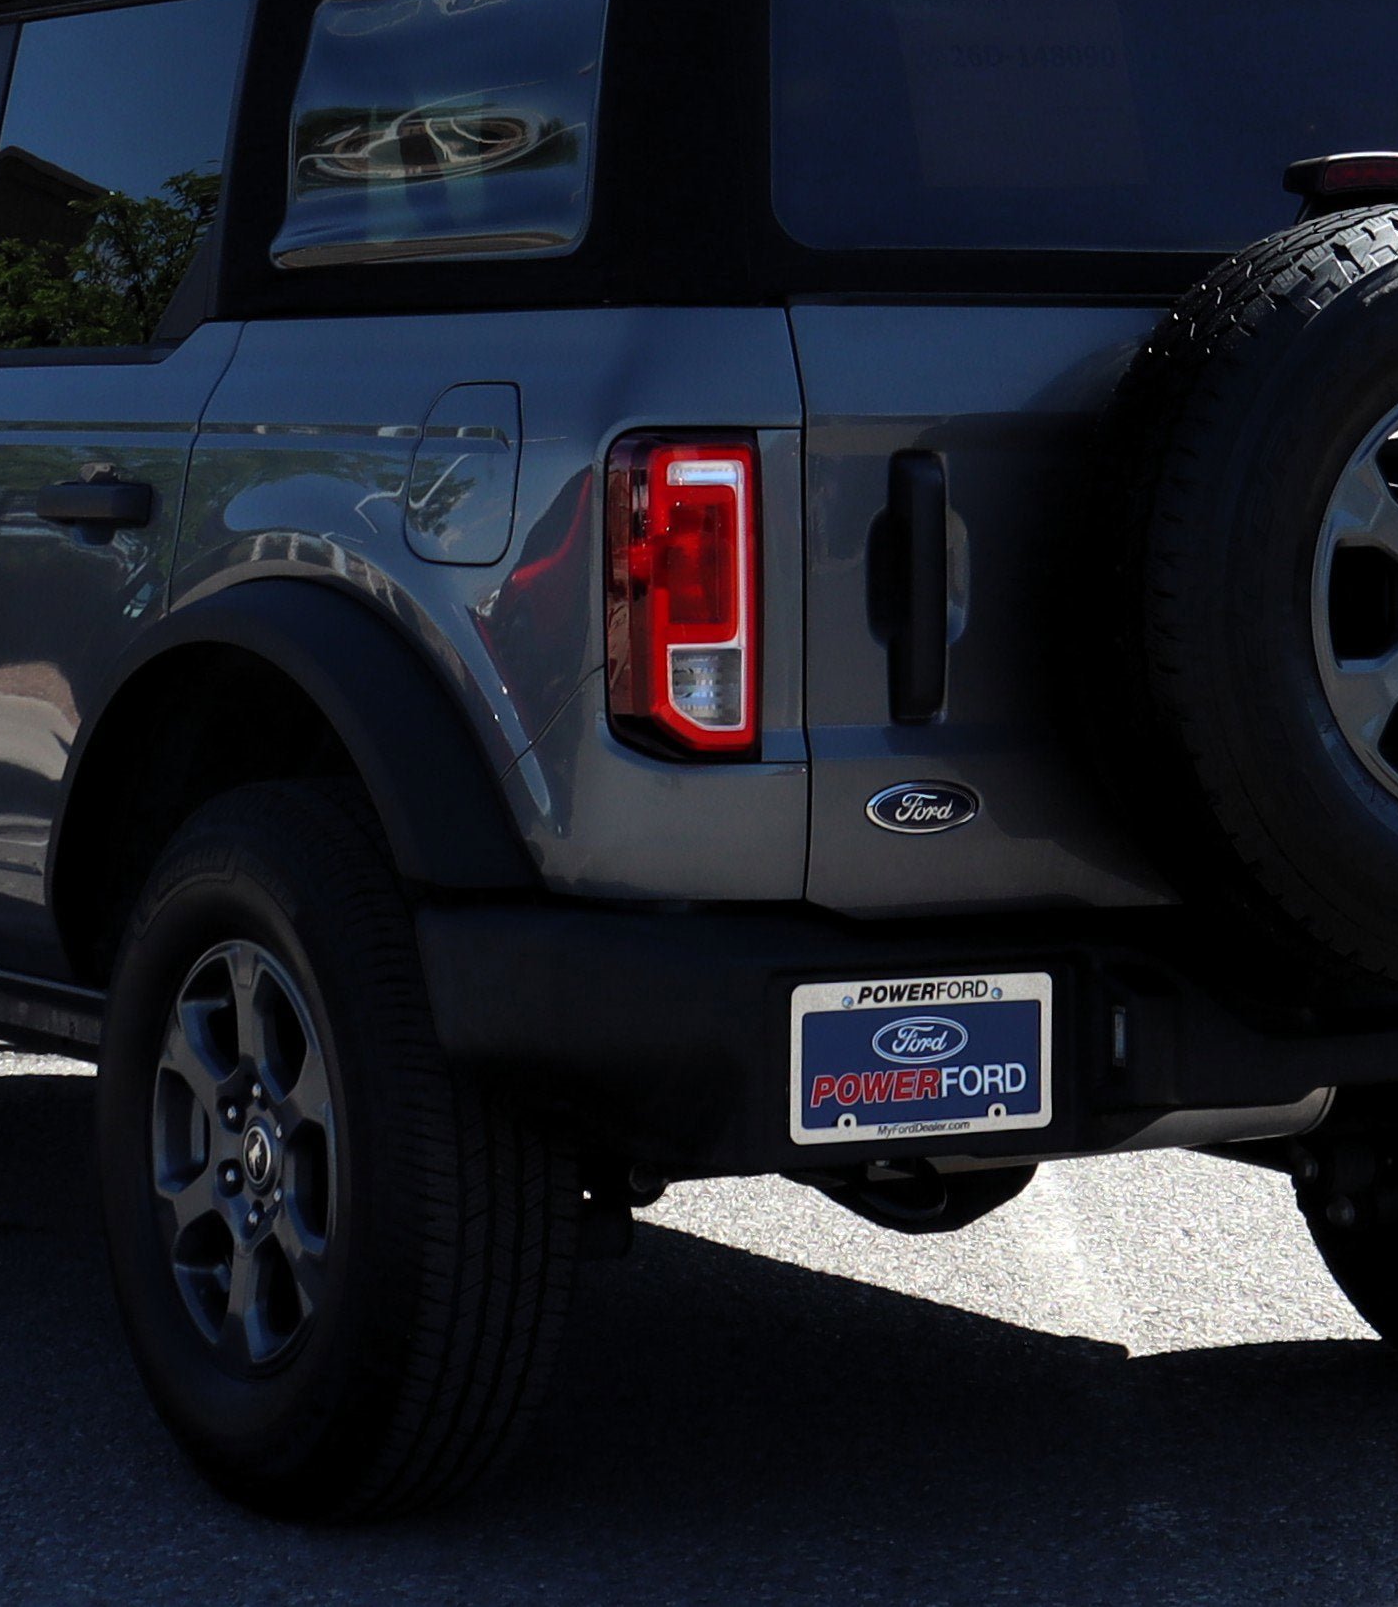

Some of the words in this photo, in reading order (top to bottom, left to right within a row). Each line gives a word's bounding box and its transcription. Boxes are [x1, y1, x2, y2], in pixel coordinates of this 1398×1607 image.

[894, 792, 954, 821] Ford
[857, 980, 988, 1004] POWERFORD
[891, 1025, 948, 1054] Ford
[810, 1062, 1027, 1108] POWERFORD
[877, 1120, 970, 1139] MyFordDealer.com
